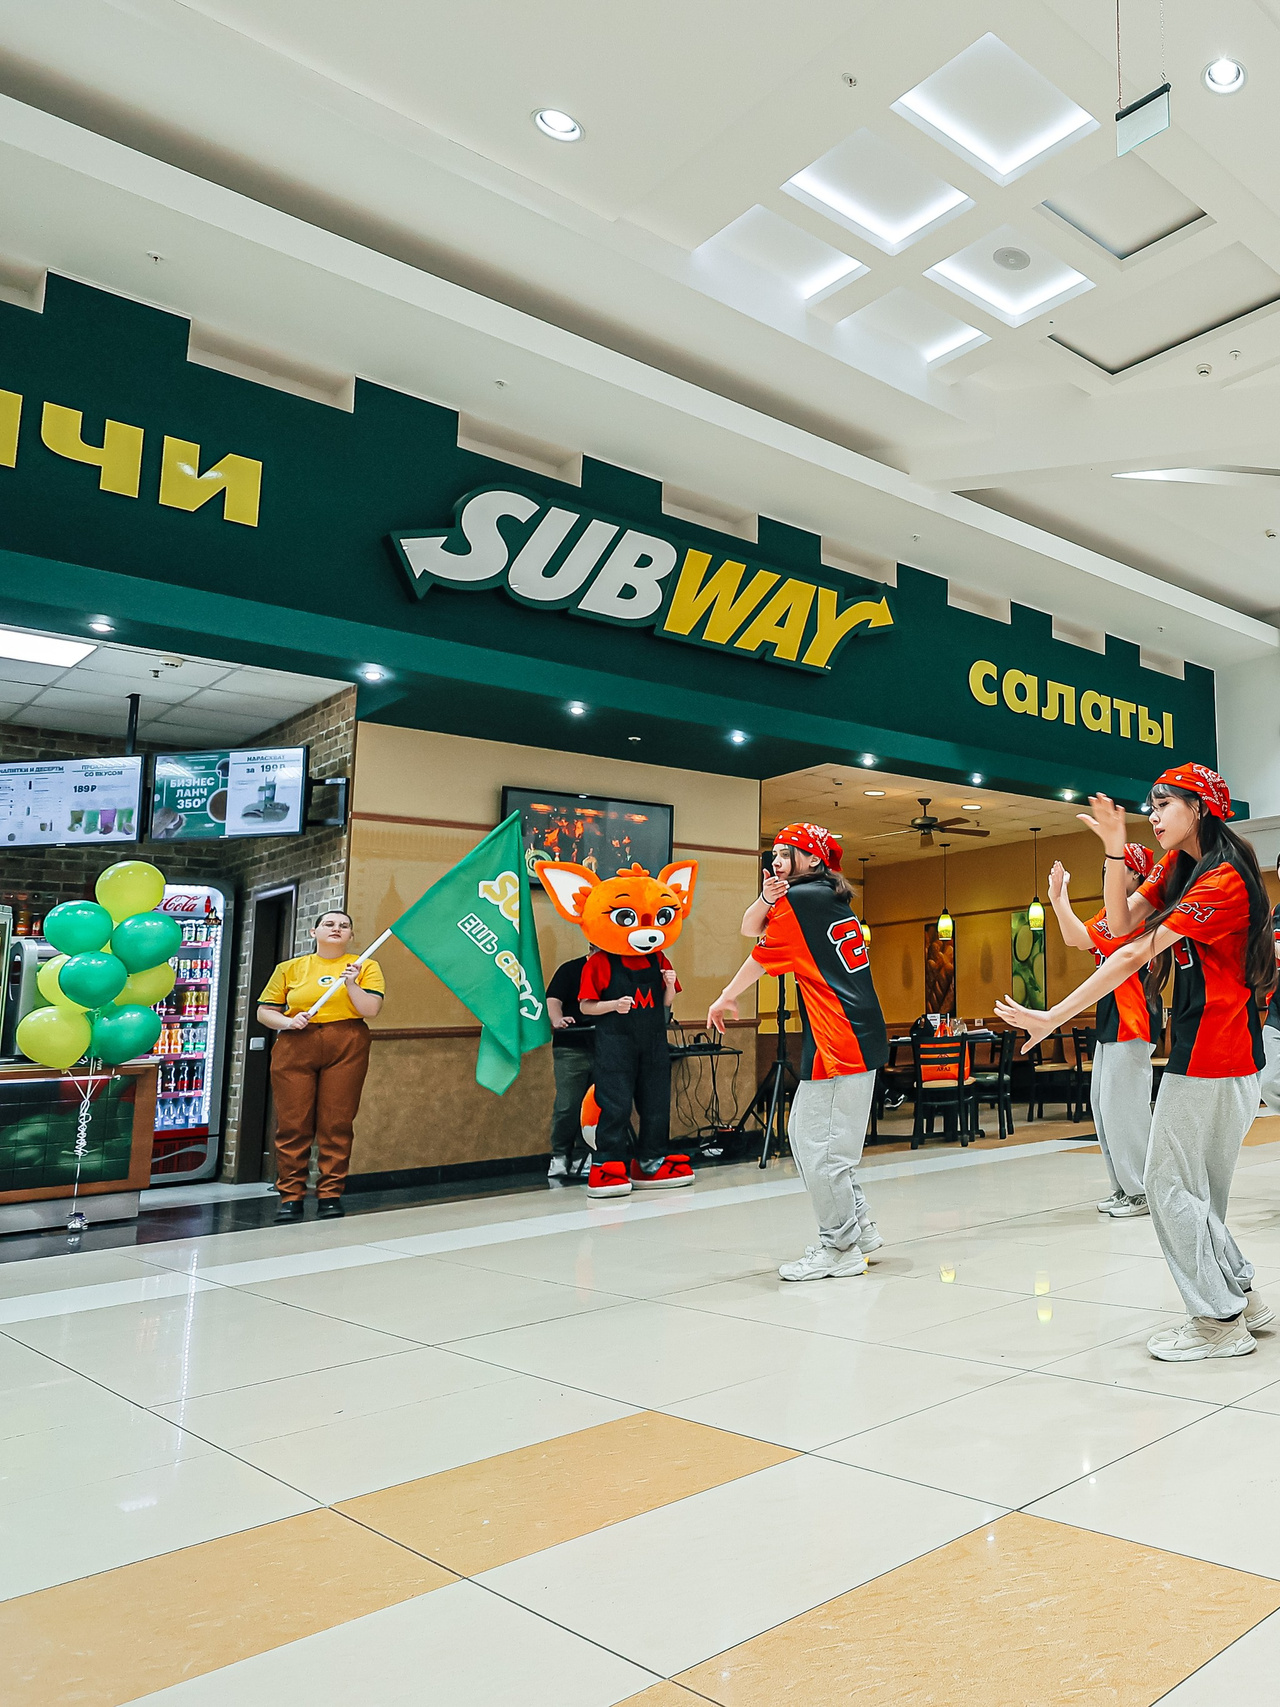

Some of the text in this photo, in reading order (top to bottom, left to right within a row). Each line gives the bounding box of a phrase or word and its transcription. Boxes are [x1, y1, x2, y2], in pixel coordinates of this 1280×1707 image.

[399, 489, 895, 669] SUBWAY
[968, 659, 1174, 749] салаты
[170, 777, 215, 788] БИЗНЕС
[175, 788, 208, 798] ЛАНЧ
